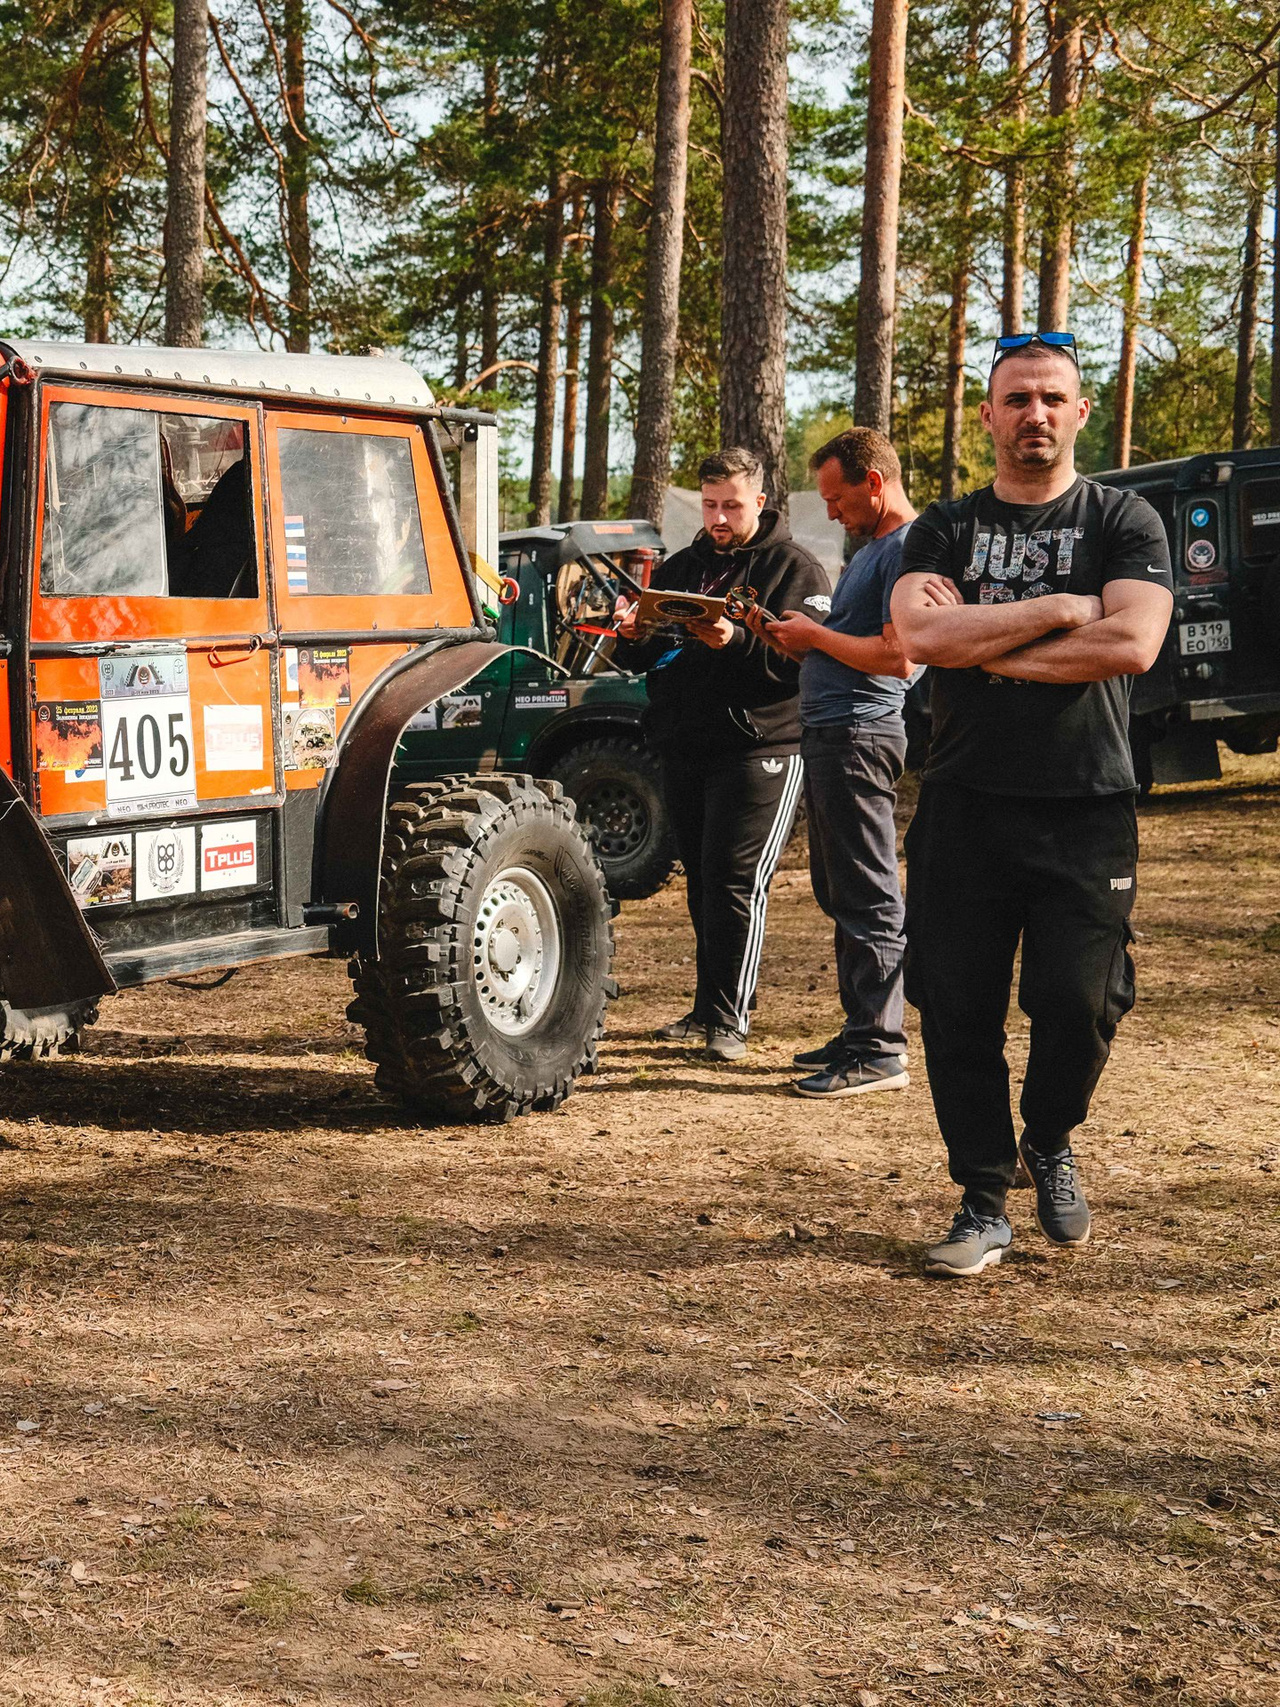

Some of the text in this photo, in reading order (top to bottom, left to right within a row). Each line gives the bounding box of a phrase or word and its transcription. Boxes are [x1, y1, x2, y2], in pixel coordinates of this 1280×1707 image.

[1252, 512, 1267, 520] NEO
[963, 527, 1085, 582] JUST
[1200, 623, 1223, 637] 319
[1210, 636, 1229, 648] 750
[515, 694, 567, 703] NEO PREMIUM
[108, 713, 189, 782] 405
[117, 804, 132, 813] NEO
[175, 798, 188, 807] NEO
[206, 849, 253, 869] TPLUS
